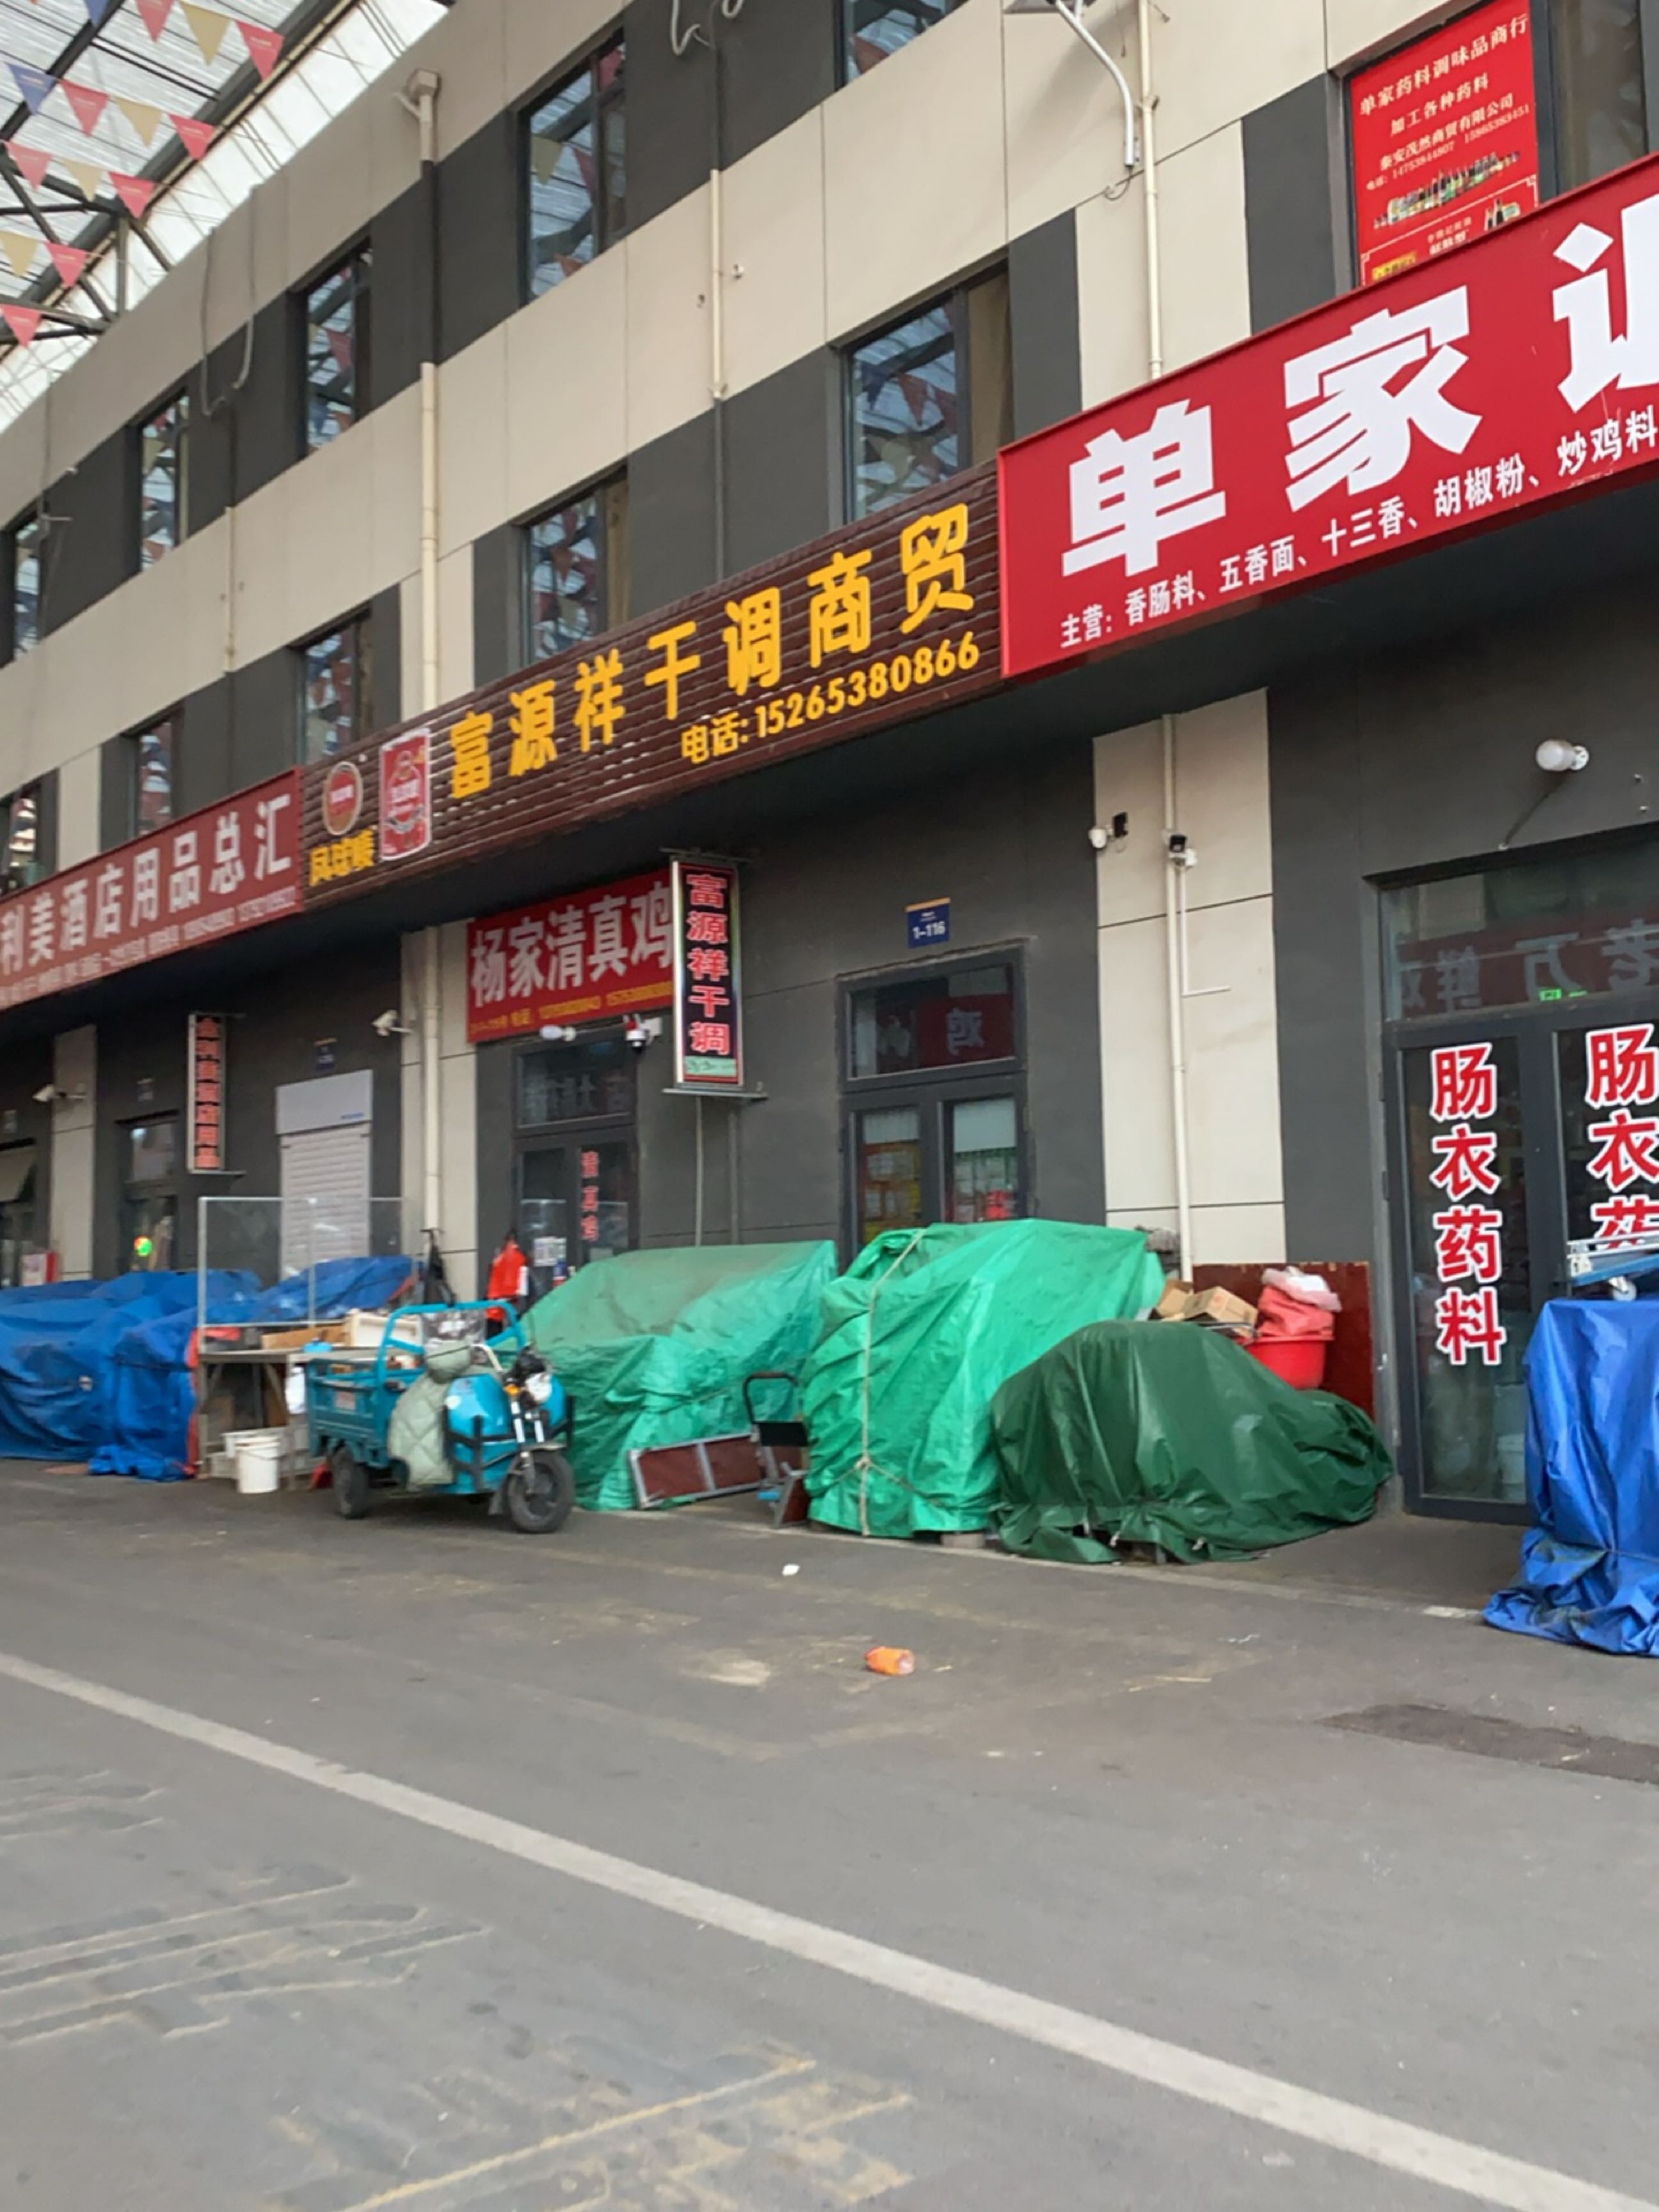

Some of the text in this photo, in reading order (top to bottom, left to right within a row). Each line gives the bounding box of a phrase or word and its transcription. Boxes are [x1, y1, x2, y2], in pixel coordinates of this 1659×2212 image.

[449, 502, 974, 800] 富源祥干调商贸
[685, 873, 731, 1056] 富源祥干调
[1429, 1041, 1507, 1366] 肠衣药料
